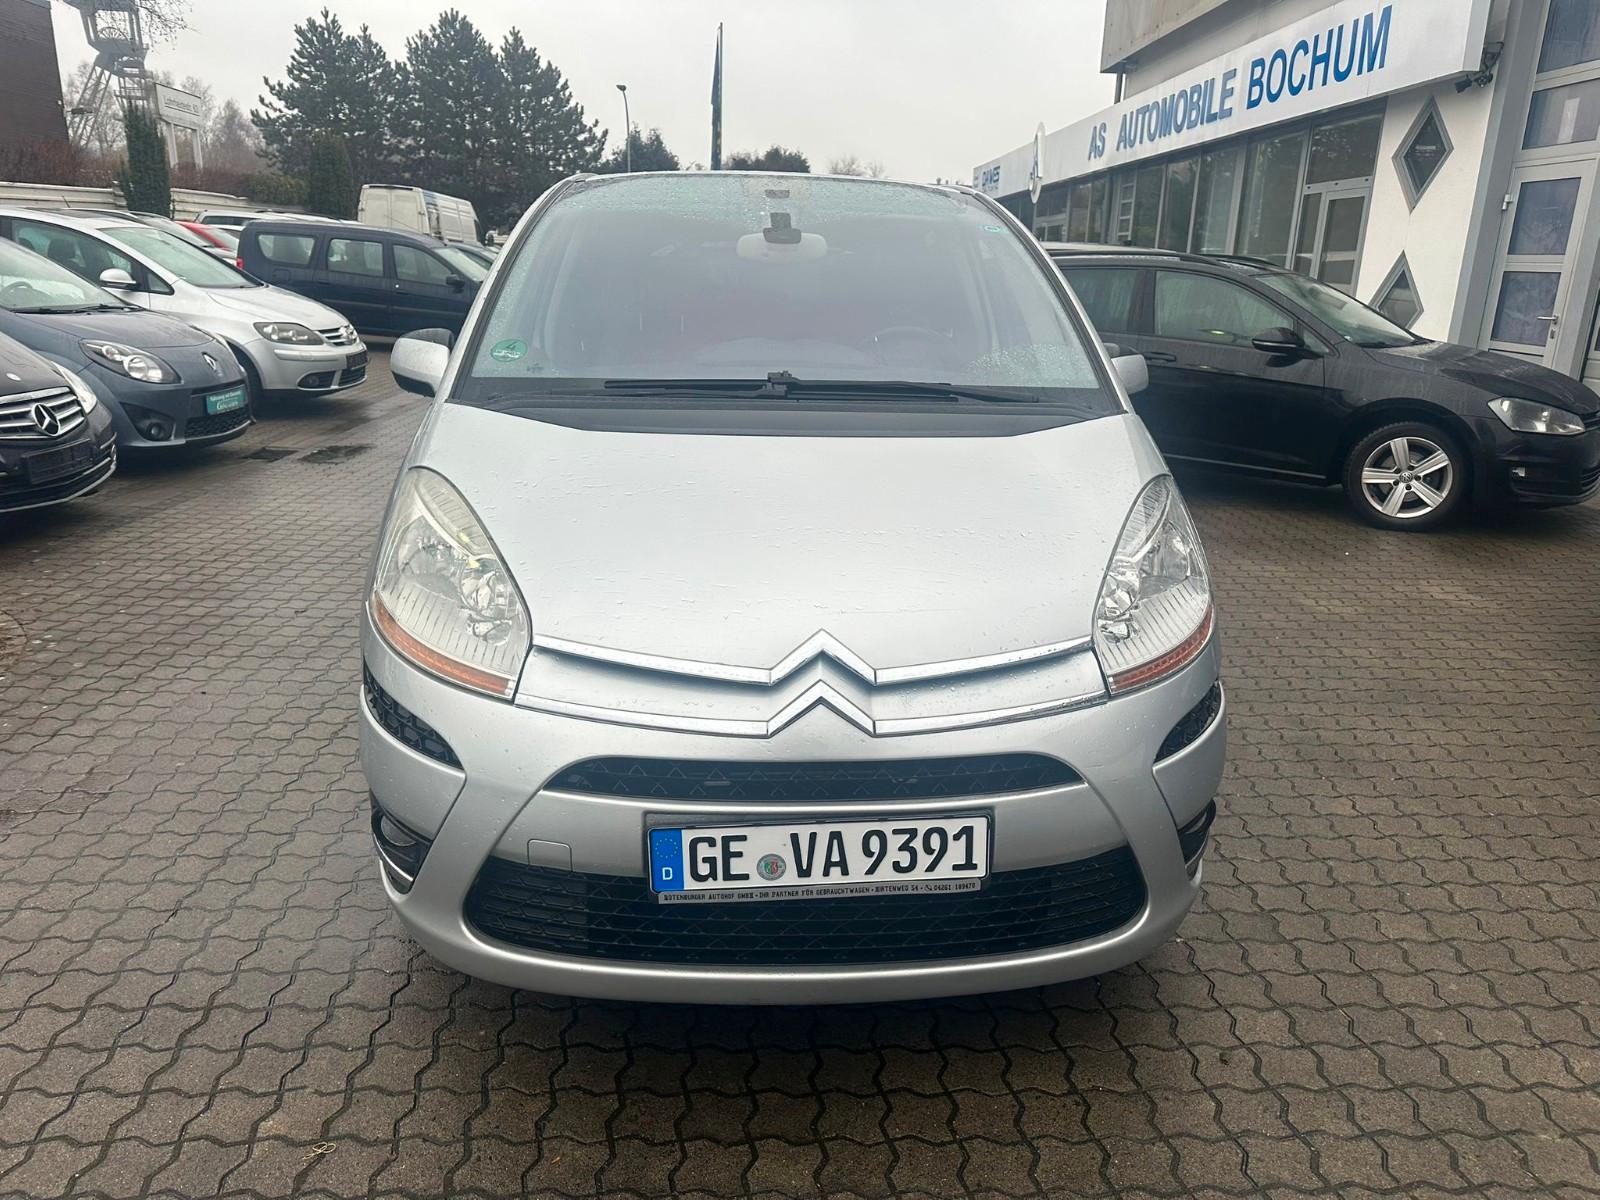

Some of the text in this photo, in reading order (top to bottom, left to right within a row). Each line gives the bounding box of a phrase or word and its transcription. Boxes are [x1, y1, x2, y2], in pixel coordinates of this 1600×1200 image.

[1088, 4, 1393, 160] AS AUTOMOBILE BOCHUM
[689, 834, 750, 883] GE
[790, 831, 850, 878] VA
[861, 825, 978, 876] 9391
[662, 867, 673, 880] D
[771, 890, 799, 898] PARTNER
[801, 888, 814, 897] FÜR
[815, 886, 870, 896] GEBRAUCHTWAGEN
